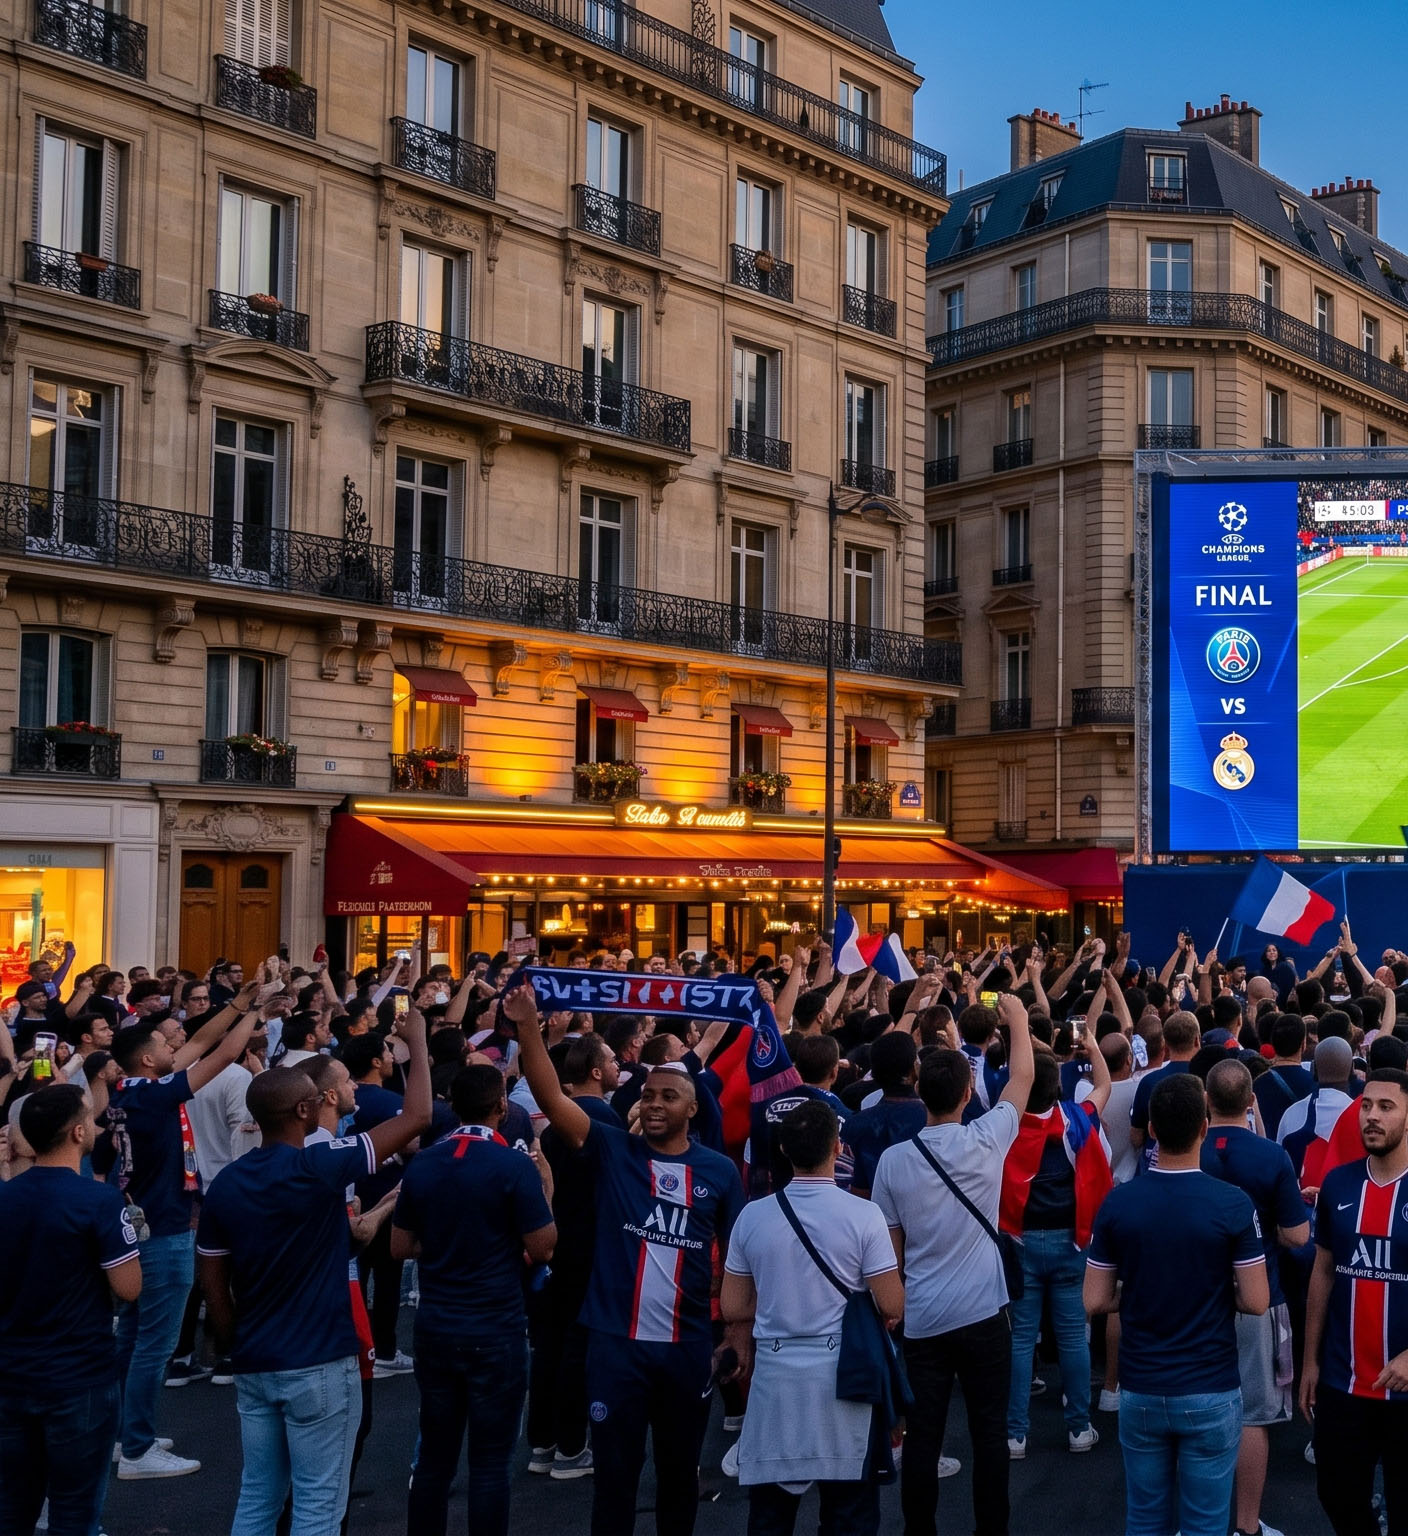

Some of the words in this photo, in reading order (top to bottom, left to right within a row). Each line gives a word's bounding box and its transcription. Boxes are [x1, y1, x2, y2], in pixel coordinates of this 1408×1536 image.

[1202, 544, 1265, 554] CHAMPIONS
[1196, 585, 1272, 606] FINAL
[1220, 697, 1246, 715] VS
